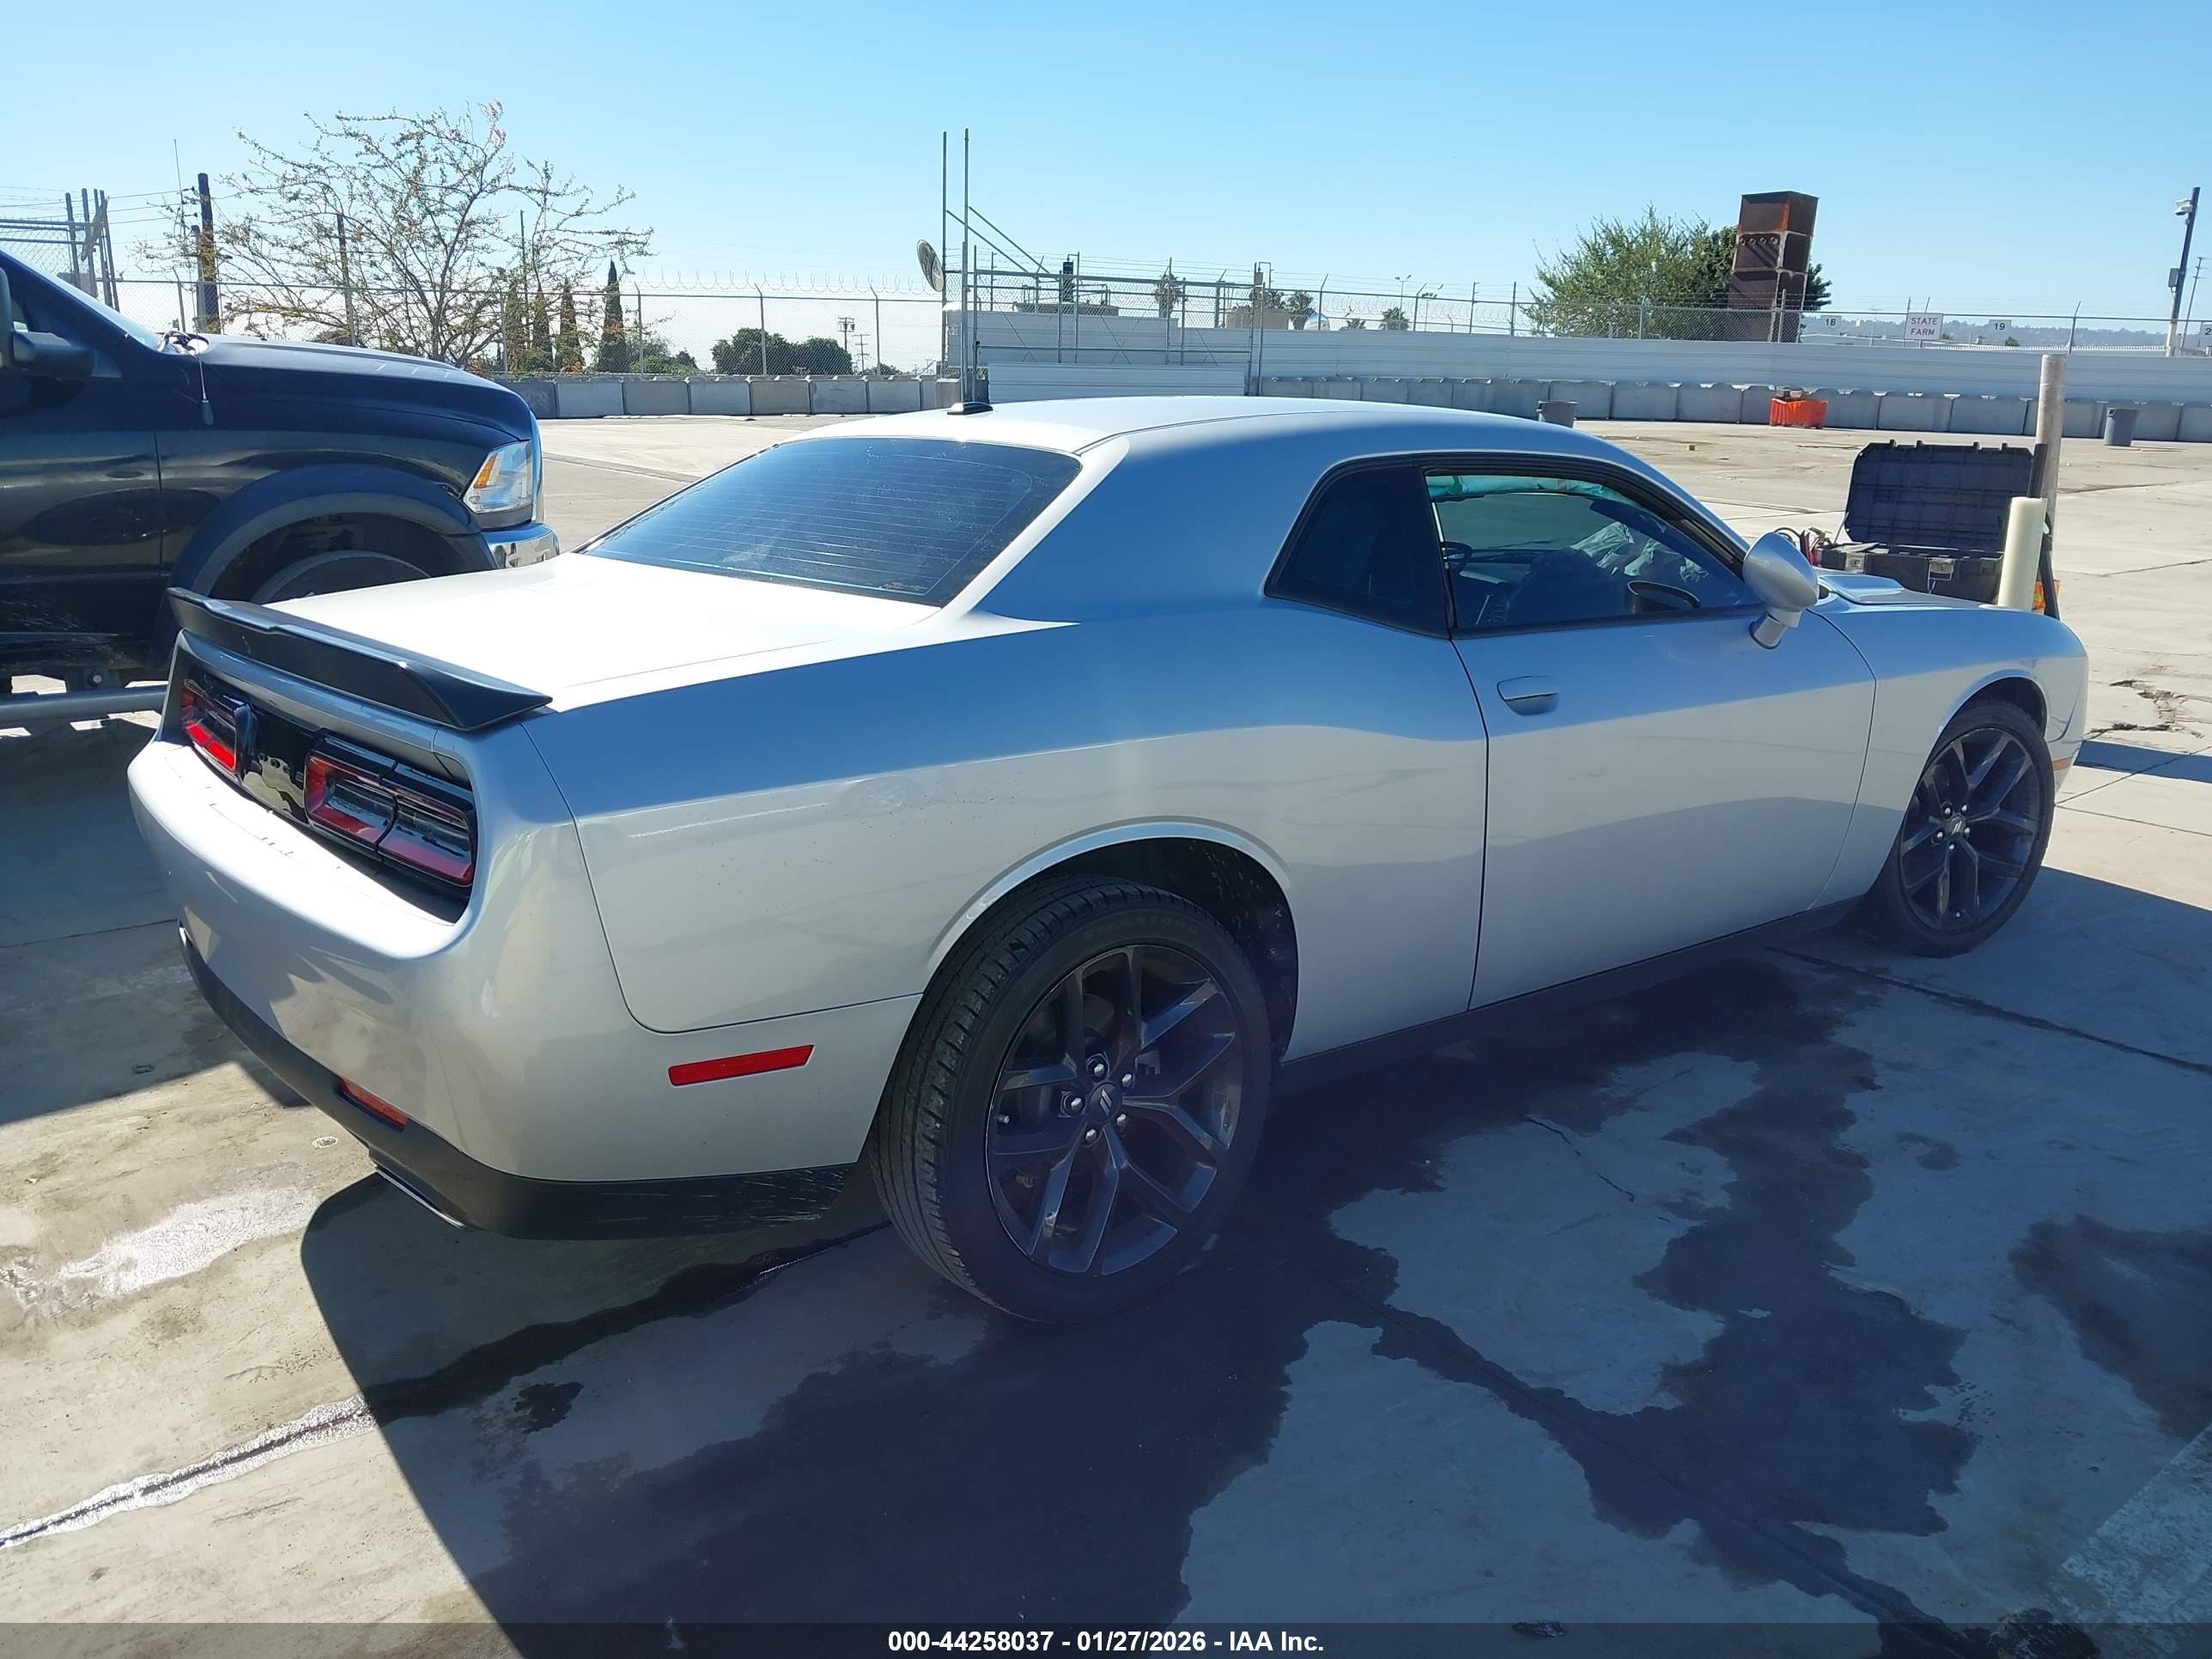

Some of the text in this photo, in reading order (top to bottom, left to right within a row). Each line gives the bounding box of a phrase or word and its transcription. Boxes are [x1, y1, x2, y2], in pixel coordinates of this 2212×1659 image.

[1825, 318, 1837, 326] 18
[1910, 317, 1938, 326] STATE
[1993, 322, 2006, 331] 19
[1910, 327, 1936, 337] FARM
[2205, 327, 2212, 336] 2
